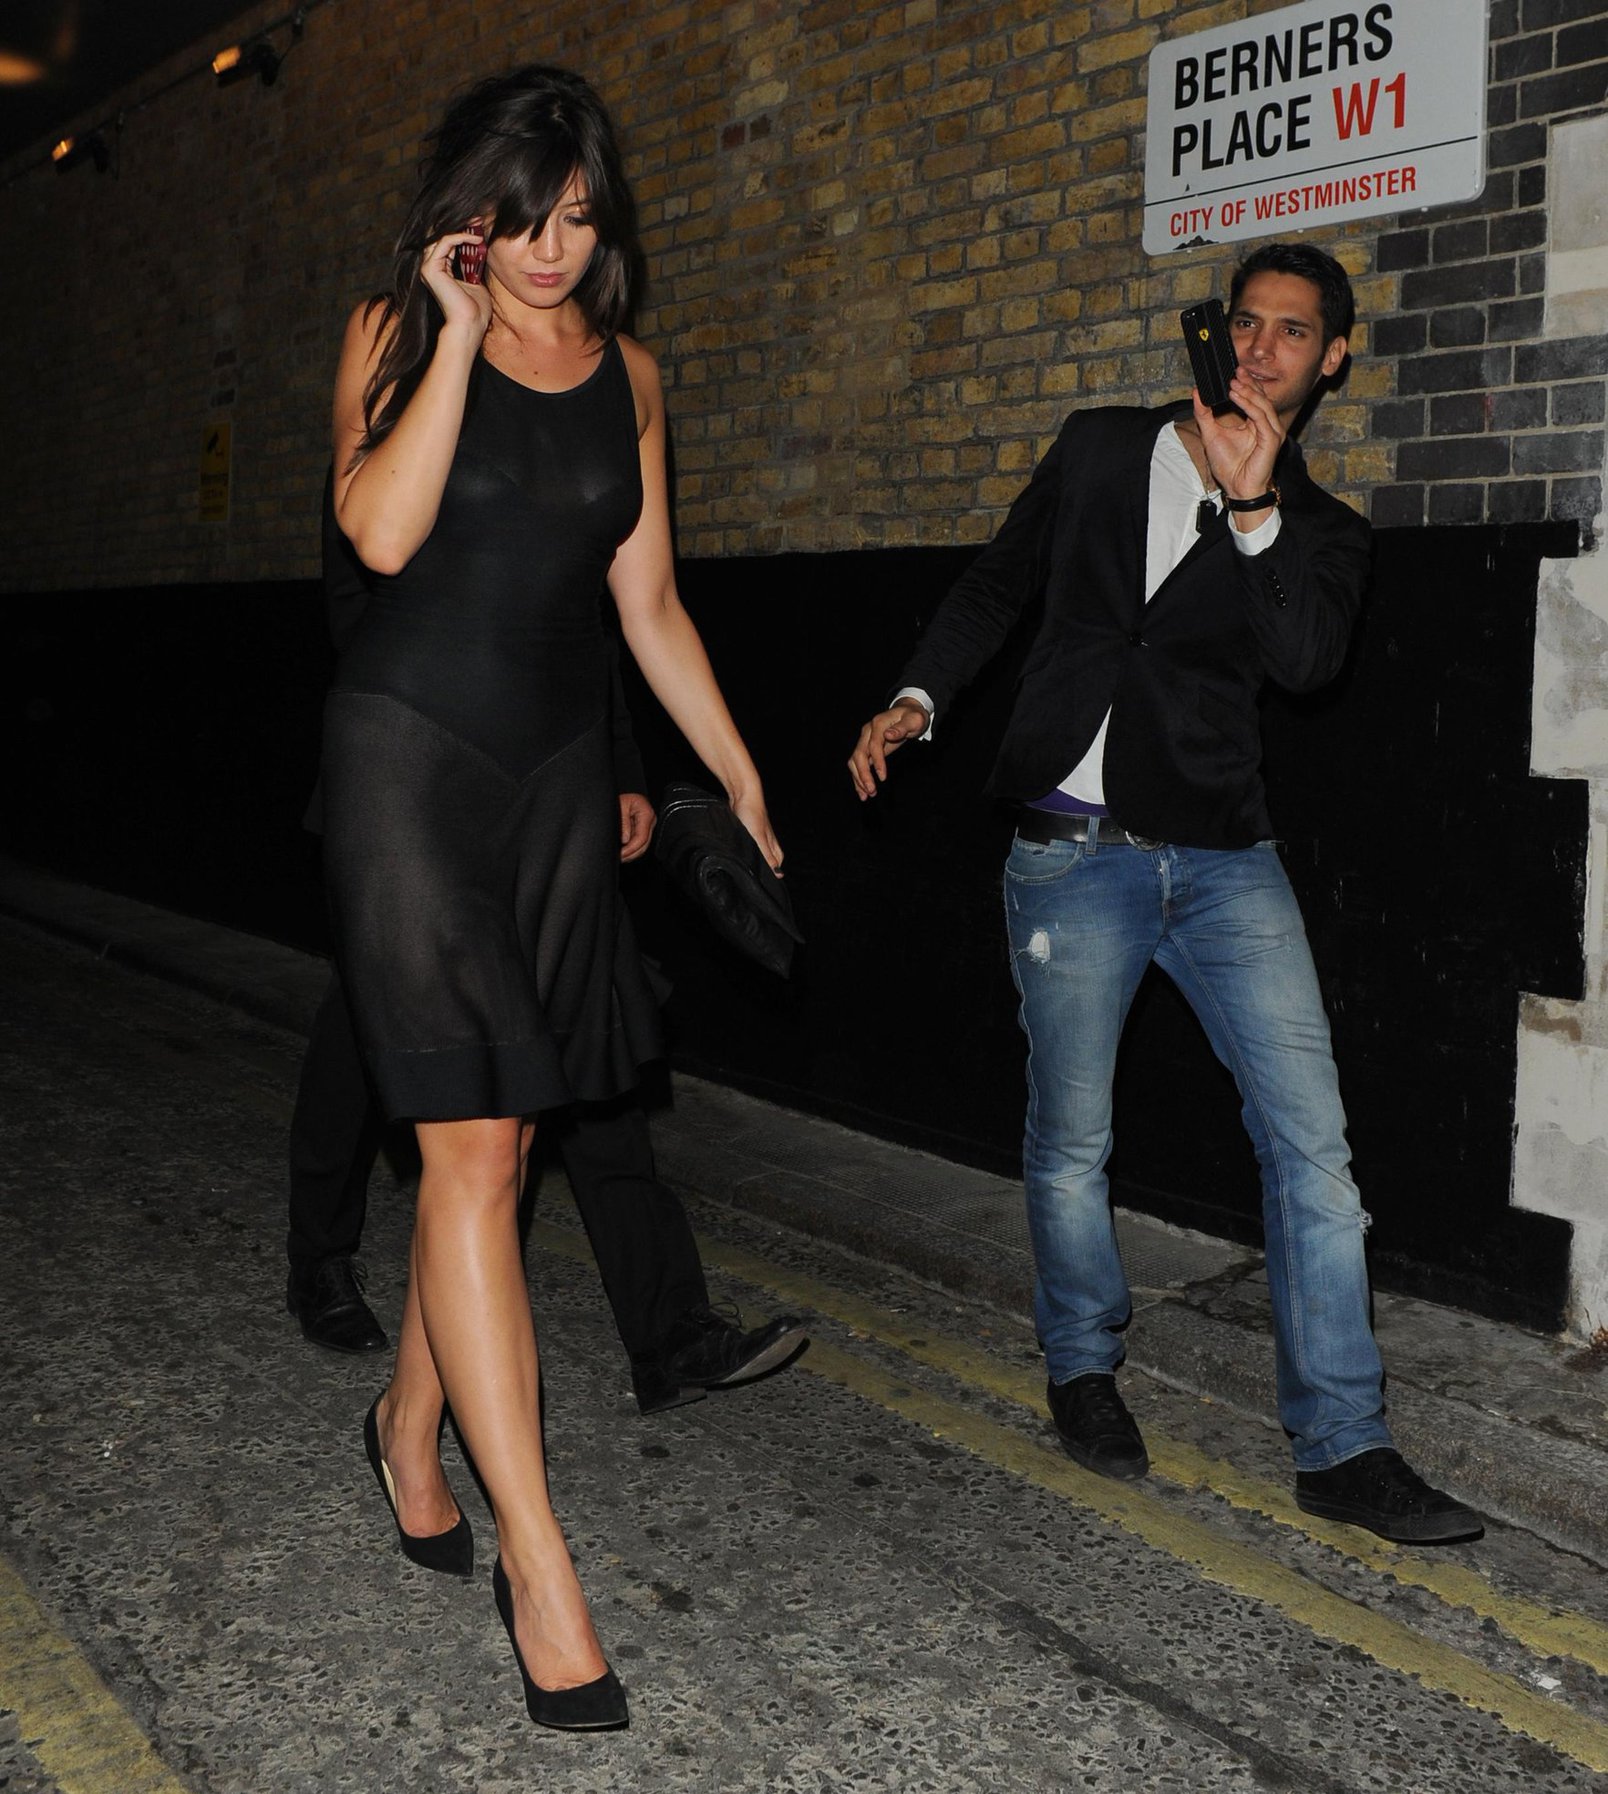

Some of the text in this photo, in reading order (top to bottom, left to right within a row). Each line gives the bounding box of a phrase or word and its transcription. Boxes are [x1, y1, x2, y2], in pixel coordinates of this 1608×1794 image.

[1174, 3, 1393, 110] BERNERS
[1172, 72, 1406, 176] PLACE W1
[1170, 166, 1416, 237] CITY OF WESTMINSTER
